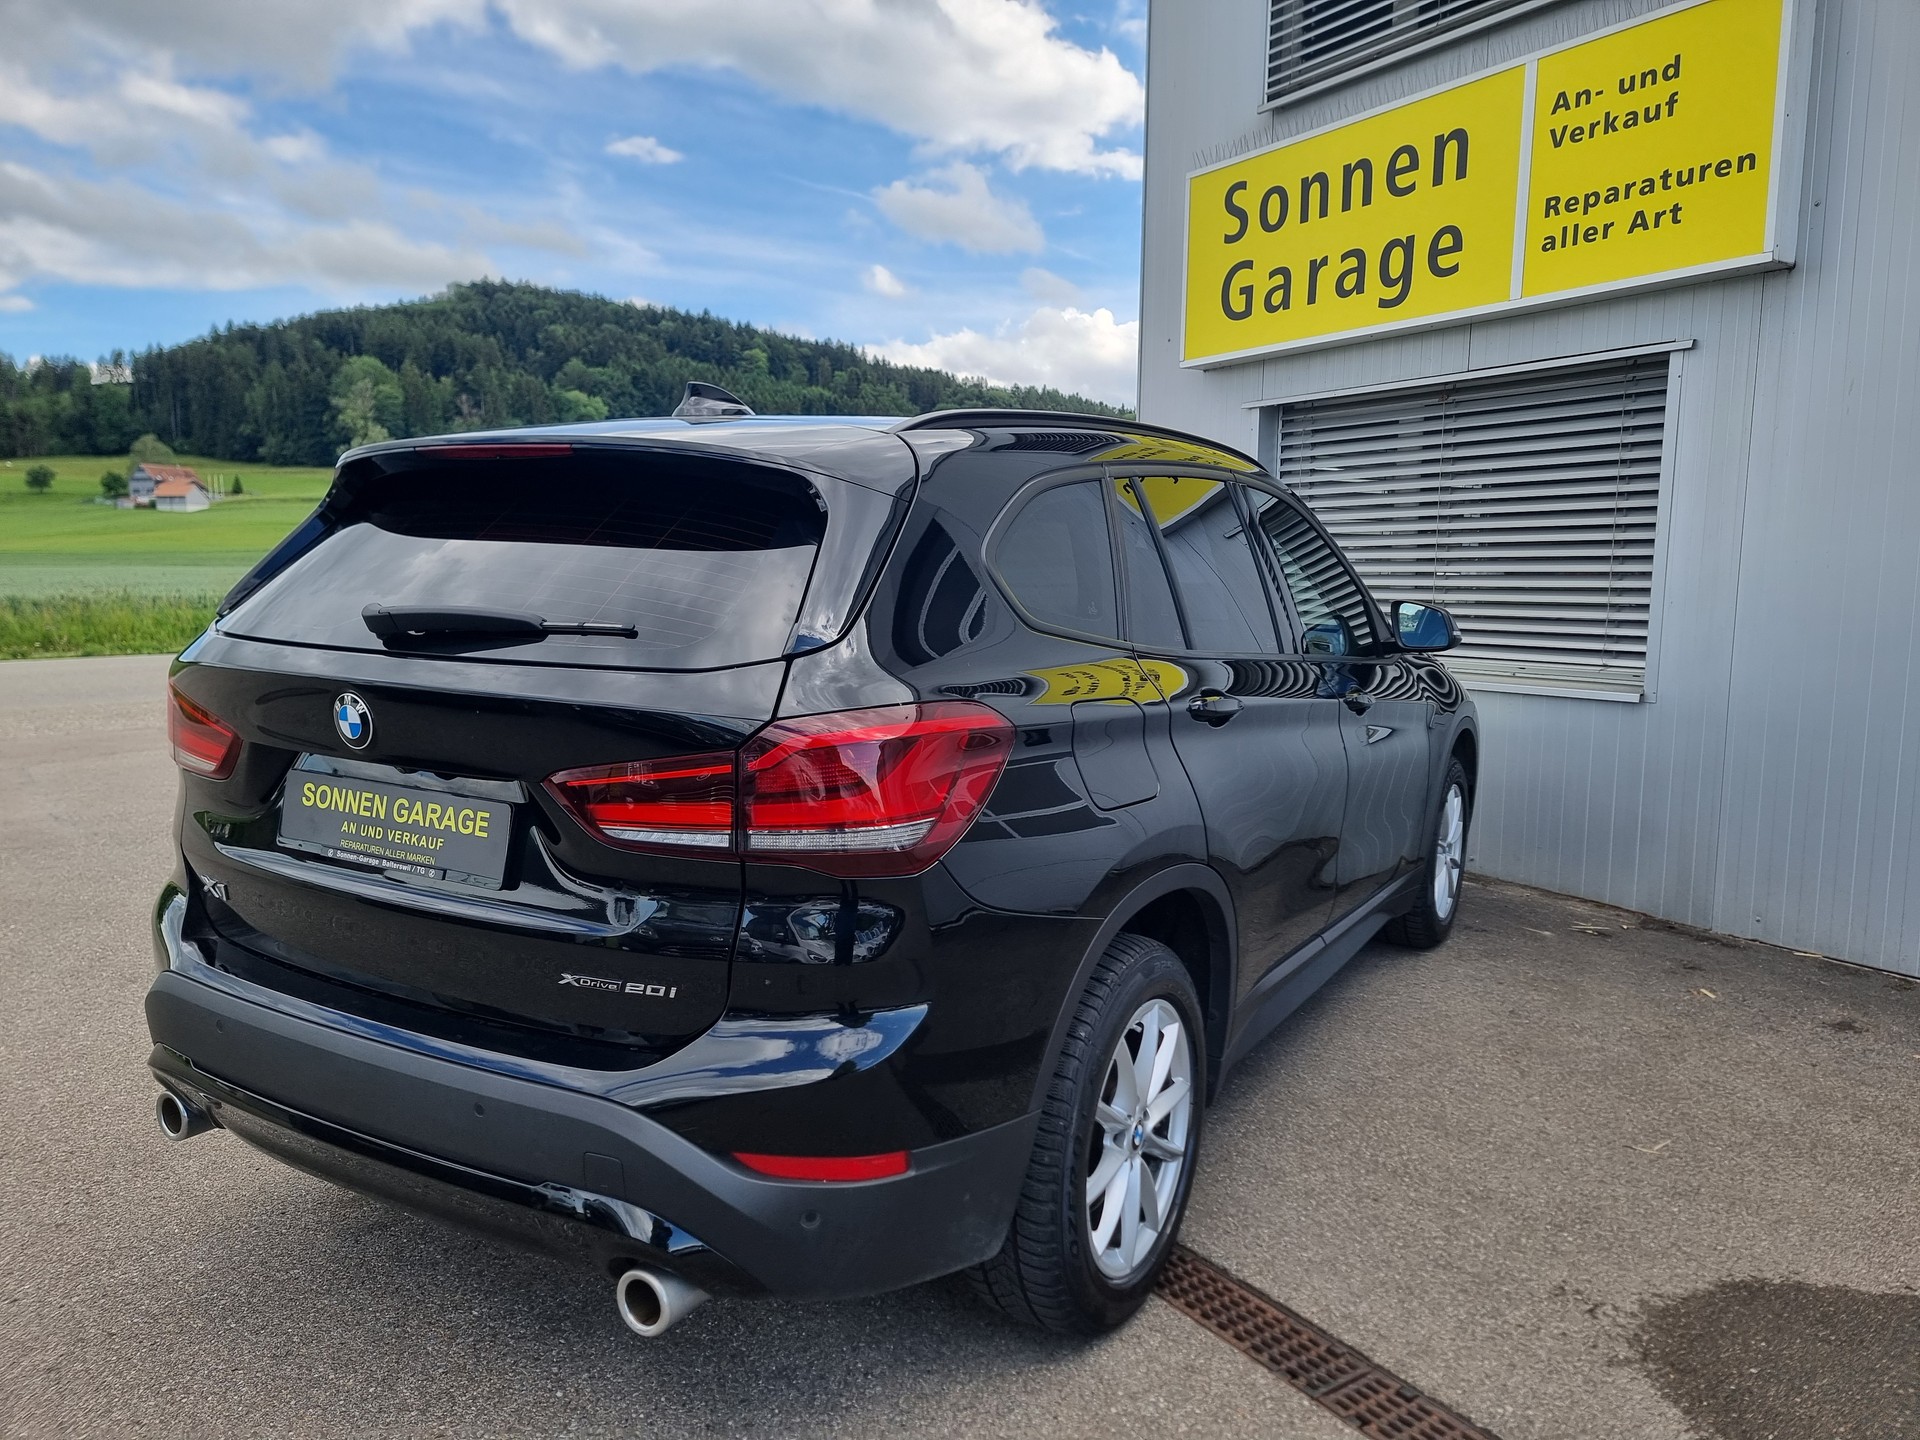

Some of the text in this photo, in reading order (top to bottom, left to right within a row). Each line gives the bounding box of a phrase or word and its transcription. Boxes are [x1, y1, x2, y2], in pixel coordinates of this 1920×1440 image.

[1550, 53, 1682, 116] An- und
[1549, 91, 1680, 149] Verkauf
[1223, 127, 1470, 245] Sonnen
[1544, 152, 1757, 219] Reparaturen
[1541, 202, 1684, 253] aller Art
[1221, 225, 1464, 321] Garage
[335, 695, 366, 714] BMW
[302, 782, 490, 837] SONNEN GARAGE
[341, 821, 445, 850] AN UND VERKAUF
[340, 839, 436, 865] REPARATUREN ALLER MARKEN
